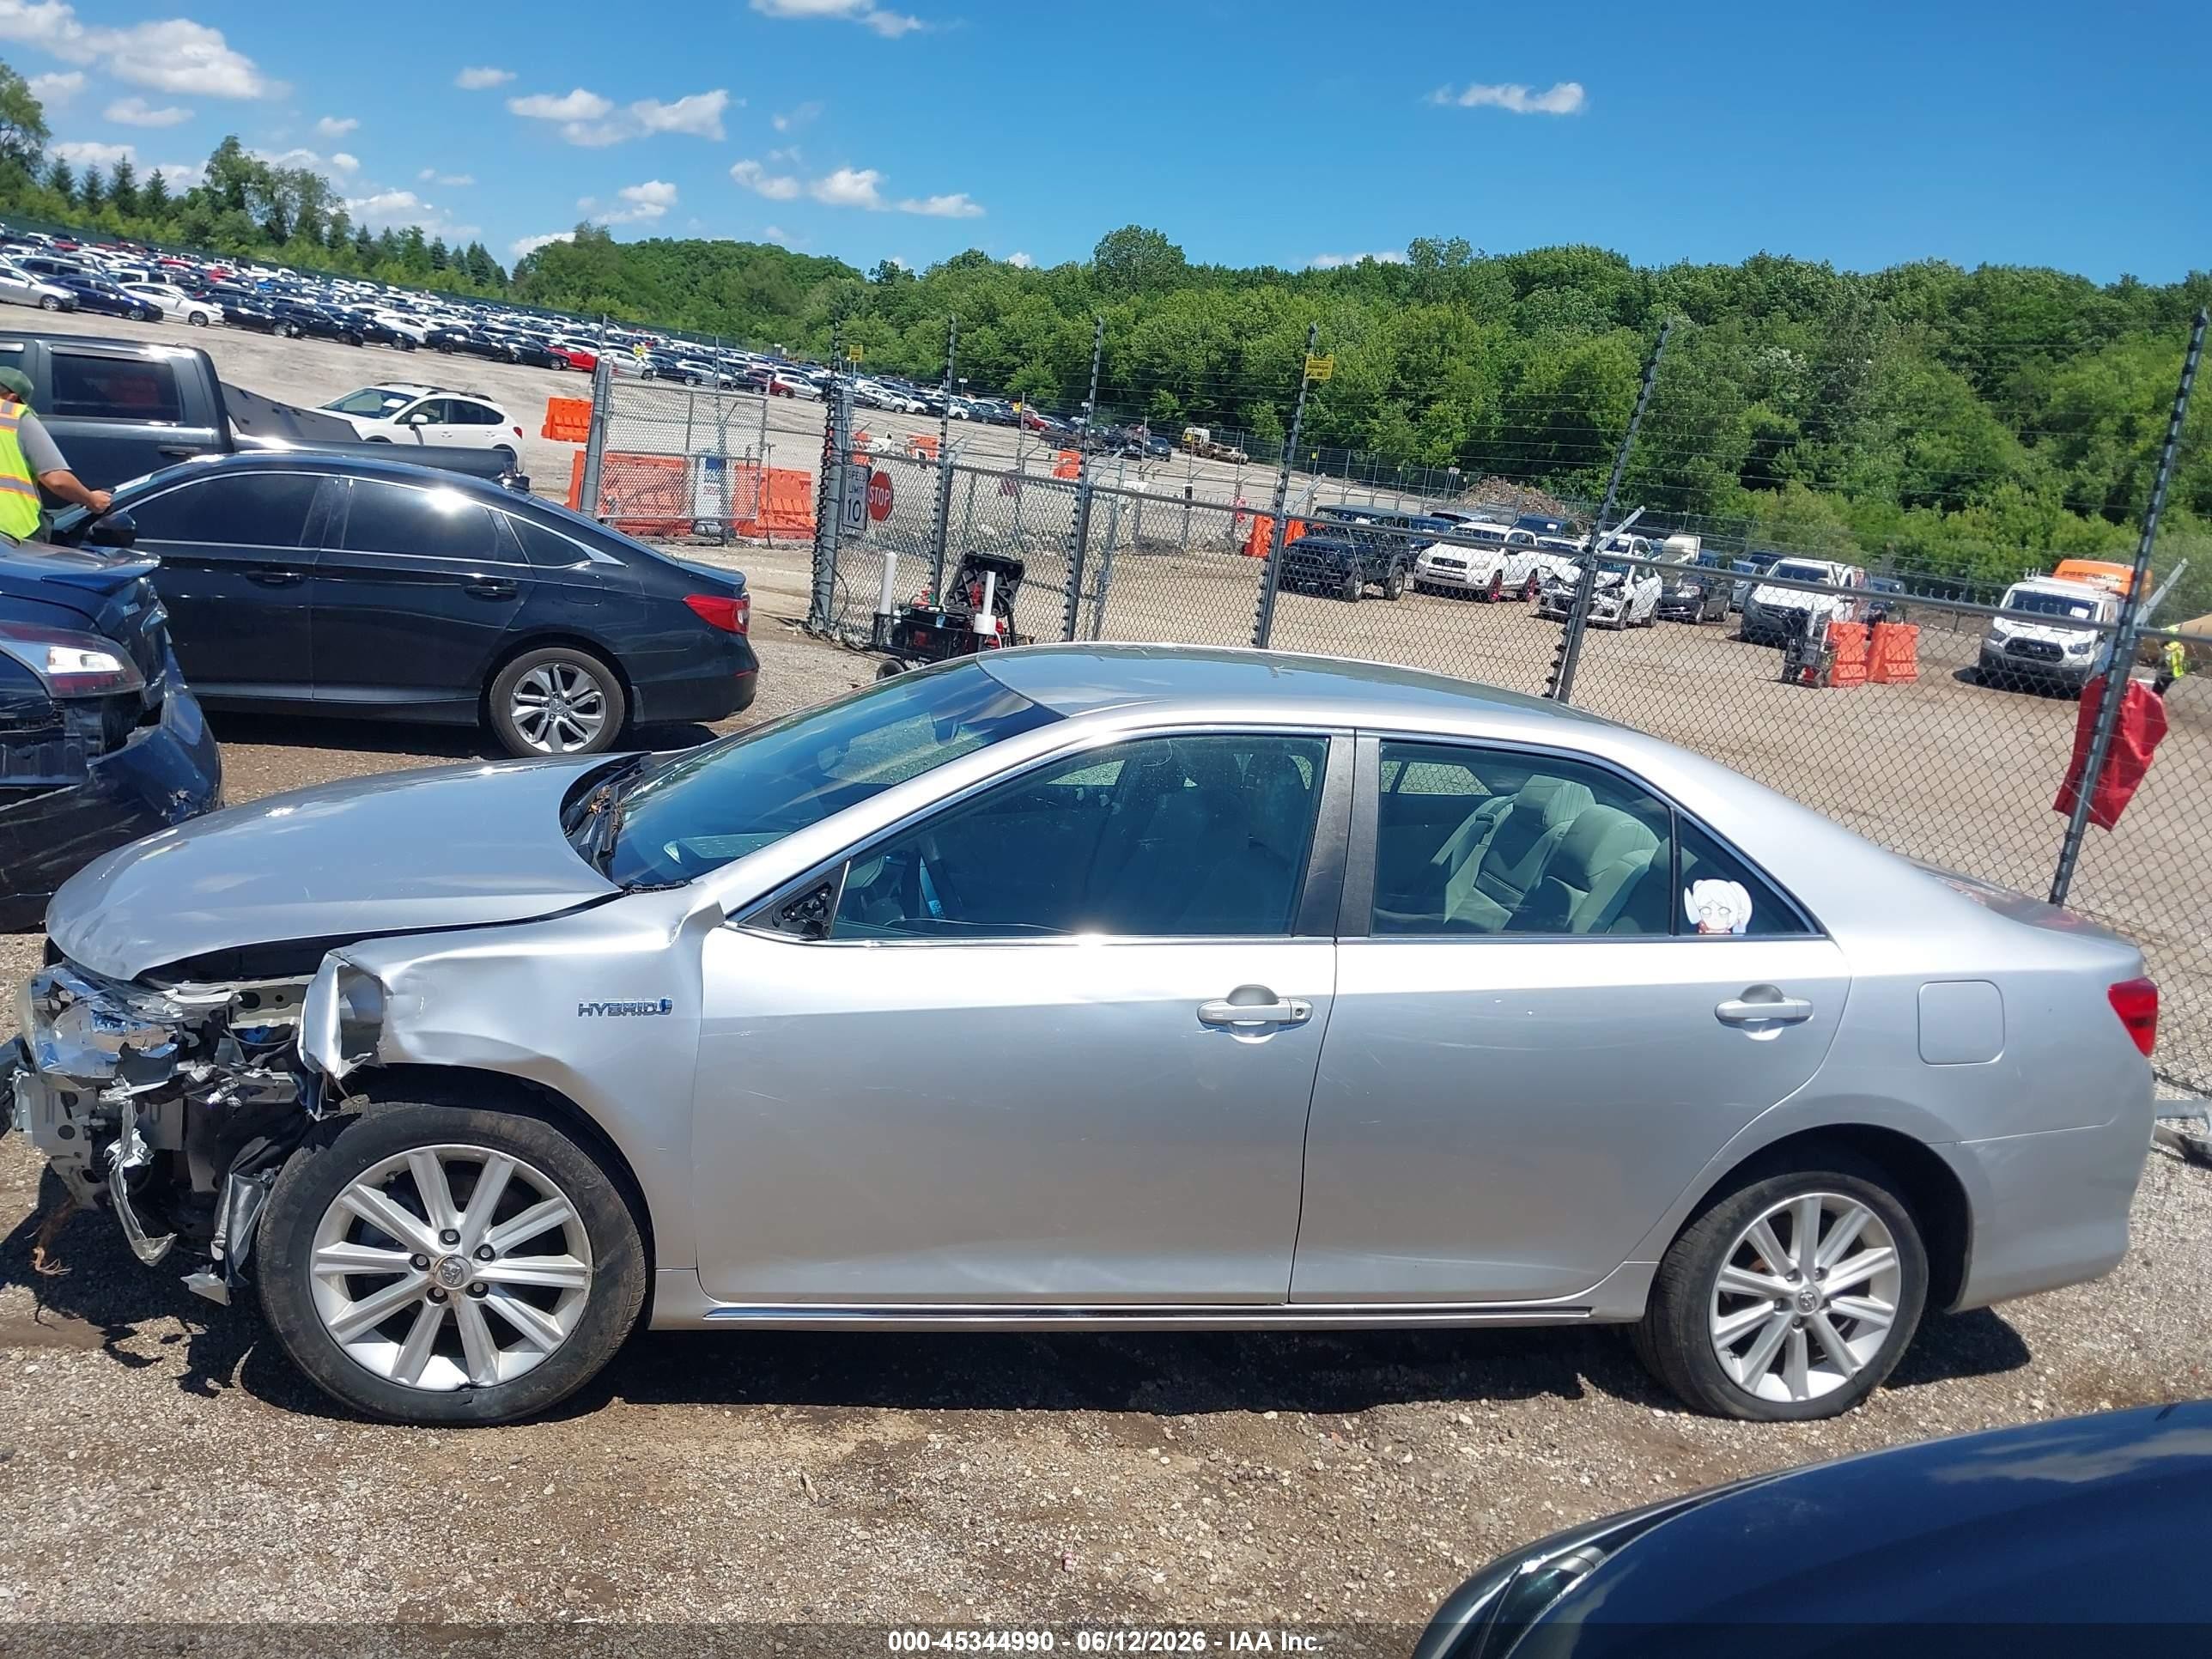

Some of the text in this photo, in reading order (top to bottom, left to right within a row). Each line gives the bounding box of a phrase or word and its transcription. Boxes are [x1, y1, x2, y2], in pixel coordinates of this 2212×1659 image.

[848, 471, 866, 482] SPEED
[848, 486, 864, 495] LIMIT
[869, 486, 890, 507] STOP
[848, 499, 861, 522] 10
[578, 1002, 658, 1017] HYBRID
